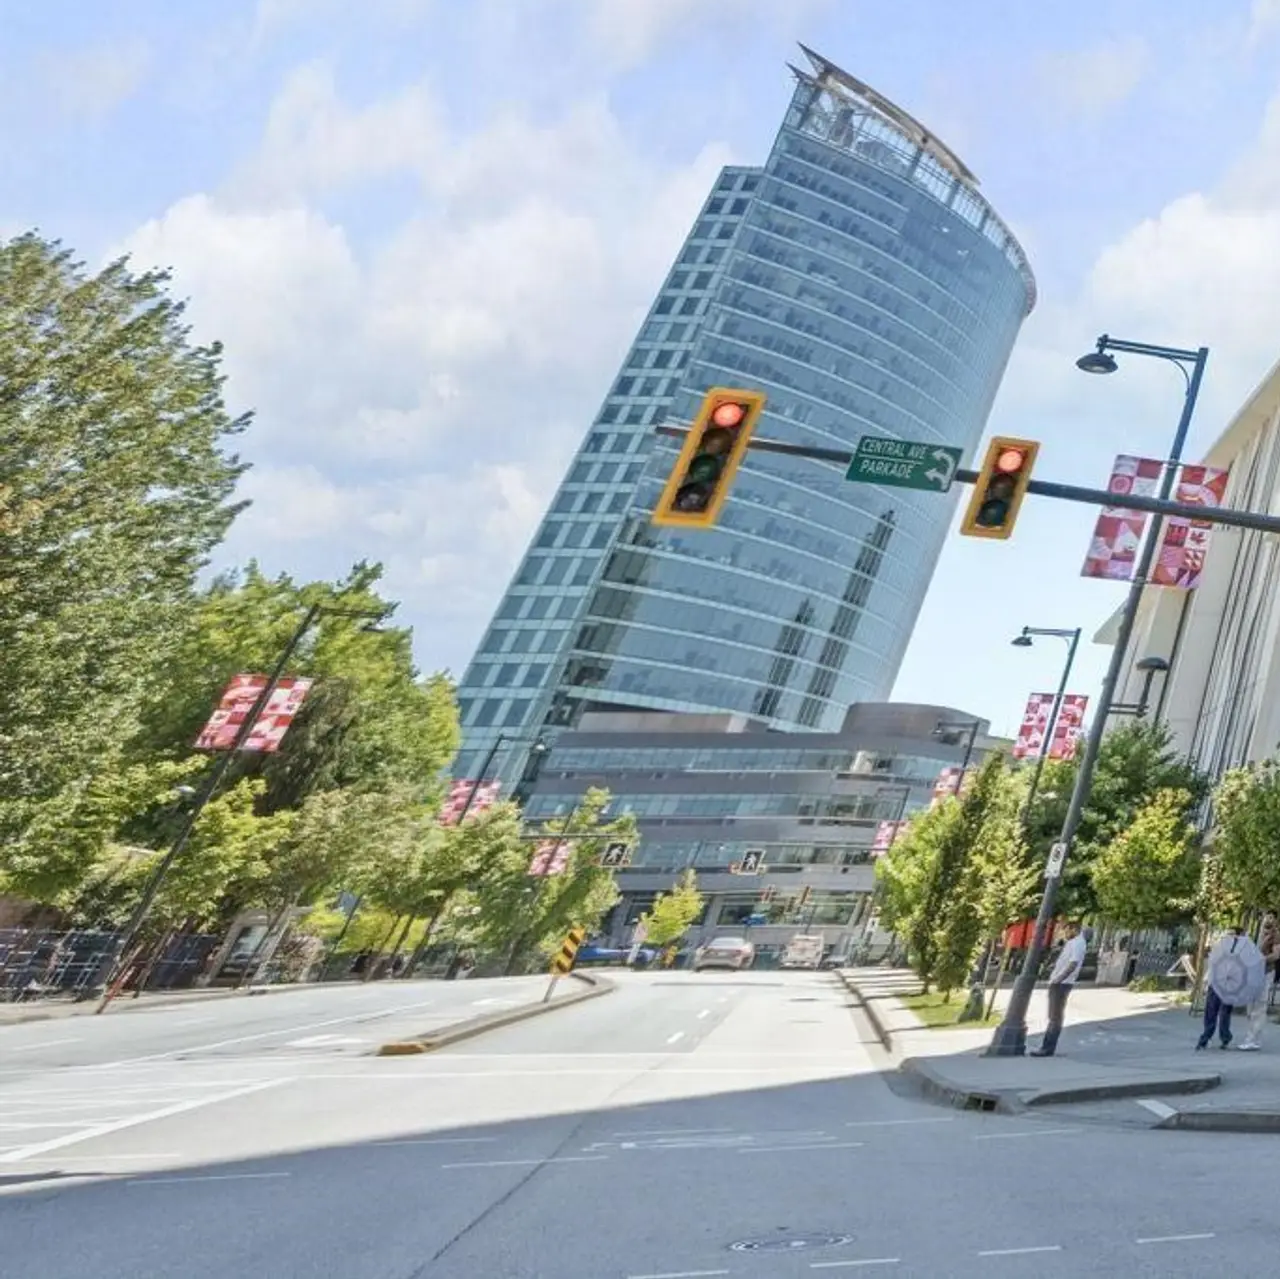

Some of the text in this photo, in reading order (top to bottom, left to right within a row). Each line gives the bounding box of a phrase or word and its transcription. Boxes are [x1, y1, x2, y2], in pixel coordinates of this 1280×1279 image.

[862, 439, 928, 460] CENTRAL AVE
[860, 459, 914, 479] PARKADE
